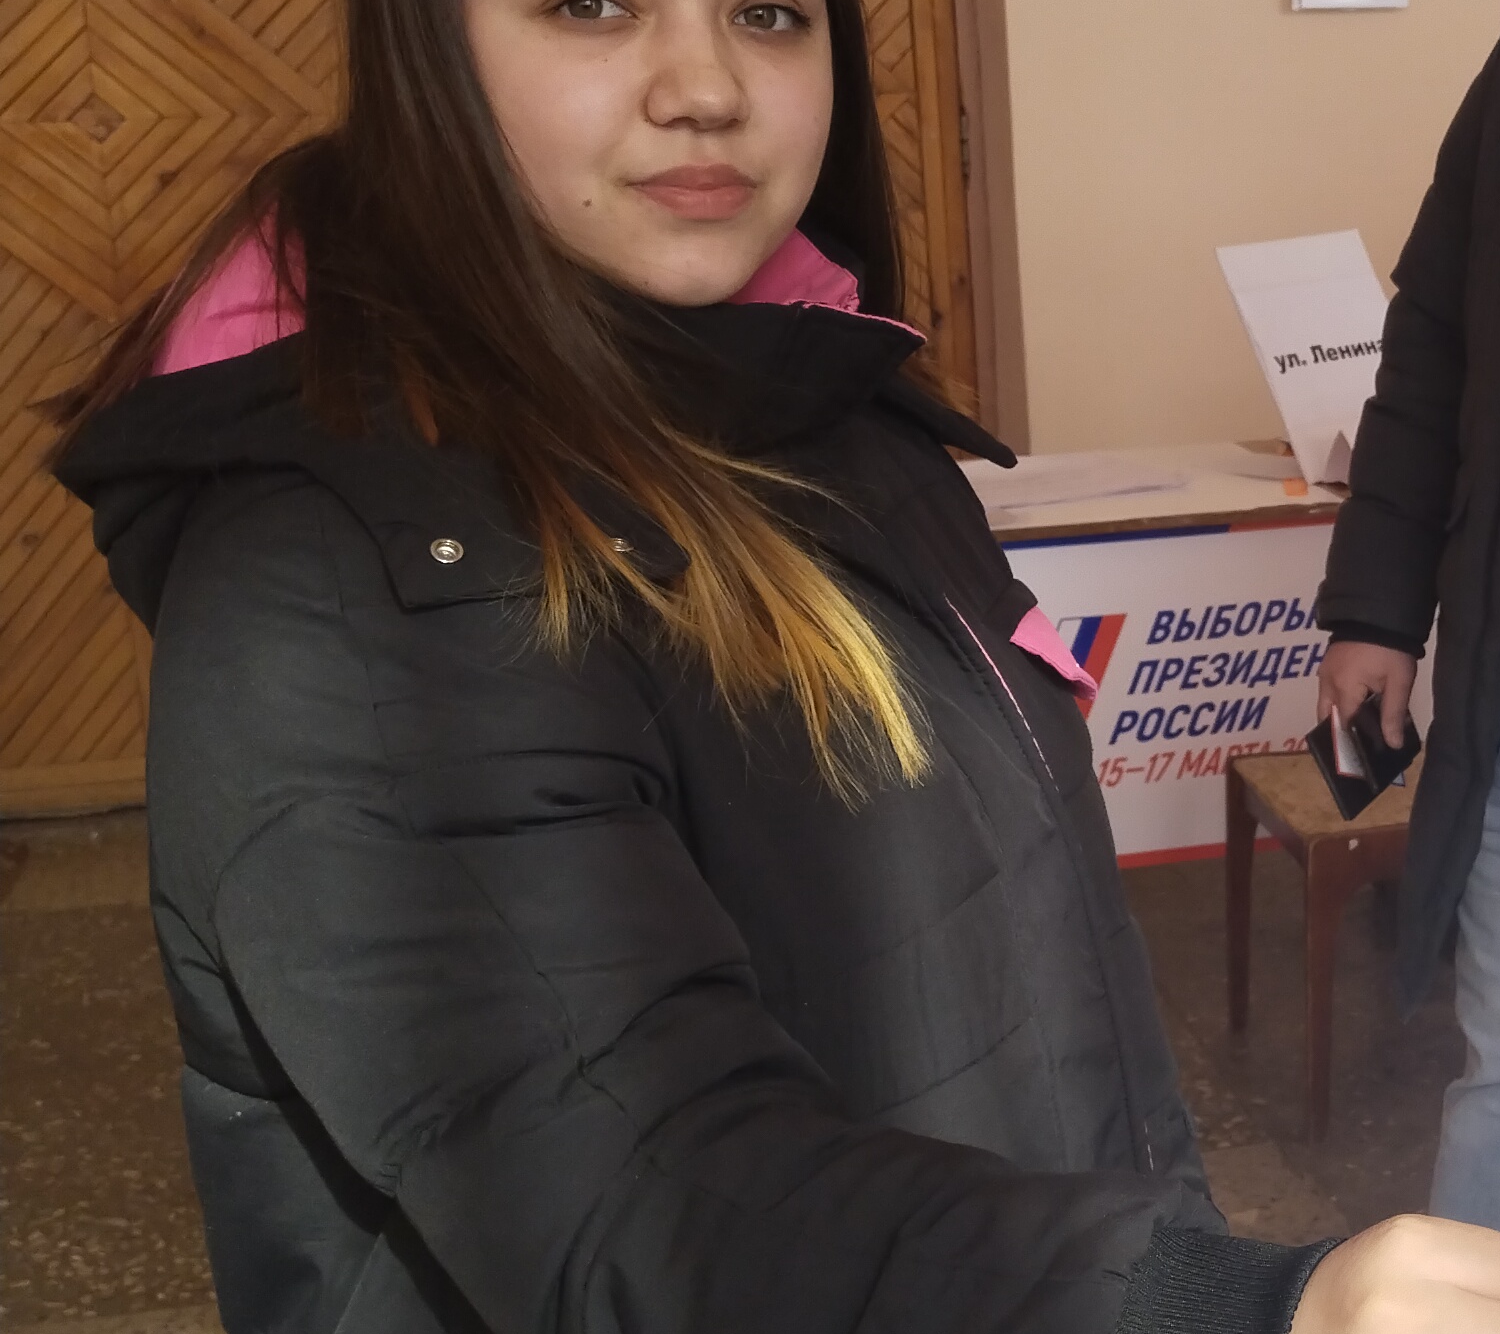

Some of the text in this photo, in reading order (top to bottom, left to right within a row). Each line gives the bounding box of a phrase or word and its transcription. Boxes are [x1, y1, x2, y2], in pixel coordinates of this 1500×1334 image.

[1273, 352, 1308, 374] ул.
[1127, 642, 1324, 695] ПРЕЗИДЕН
[1109, 695, 1270, 745] РОССИИ
